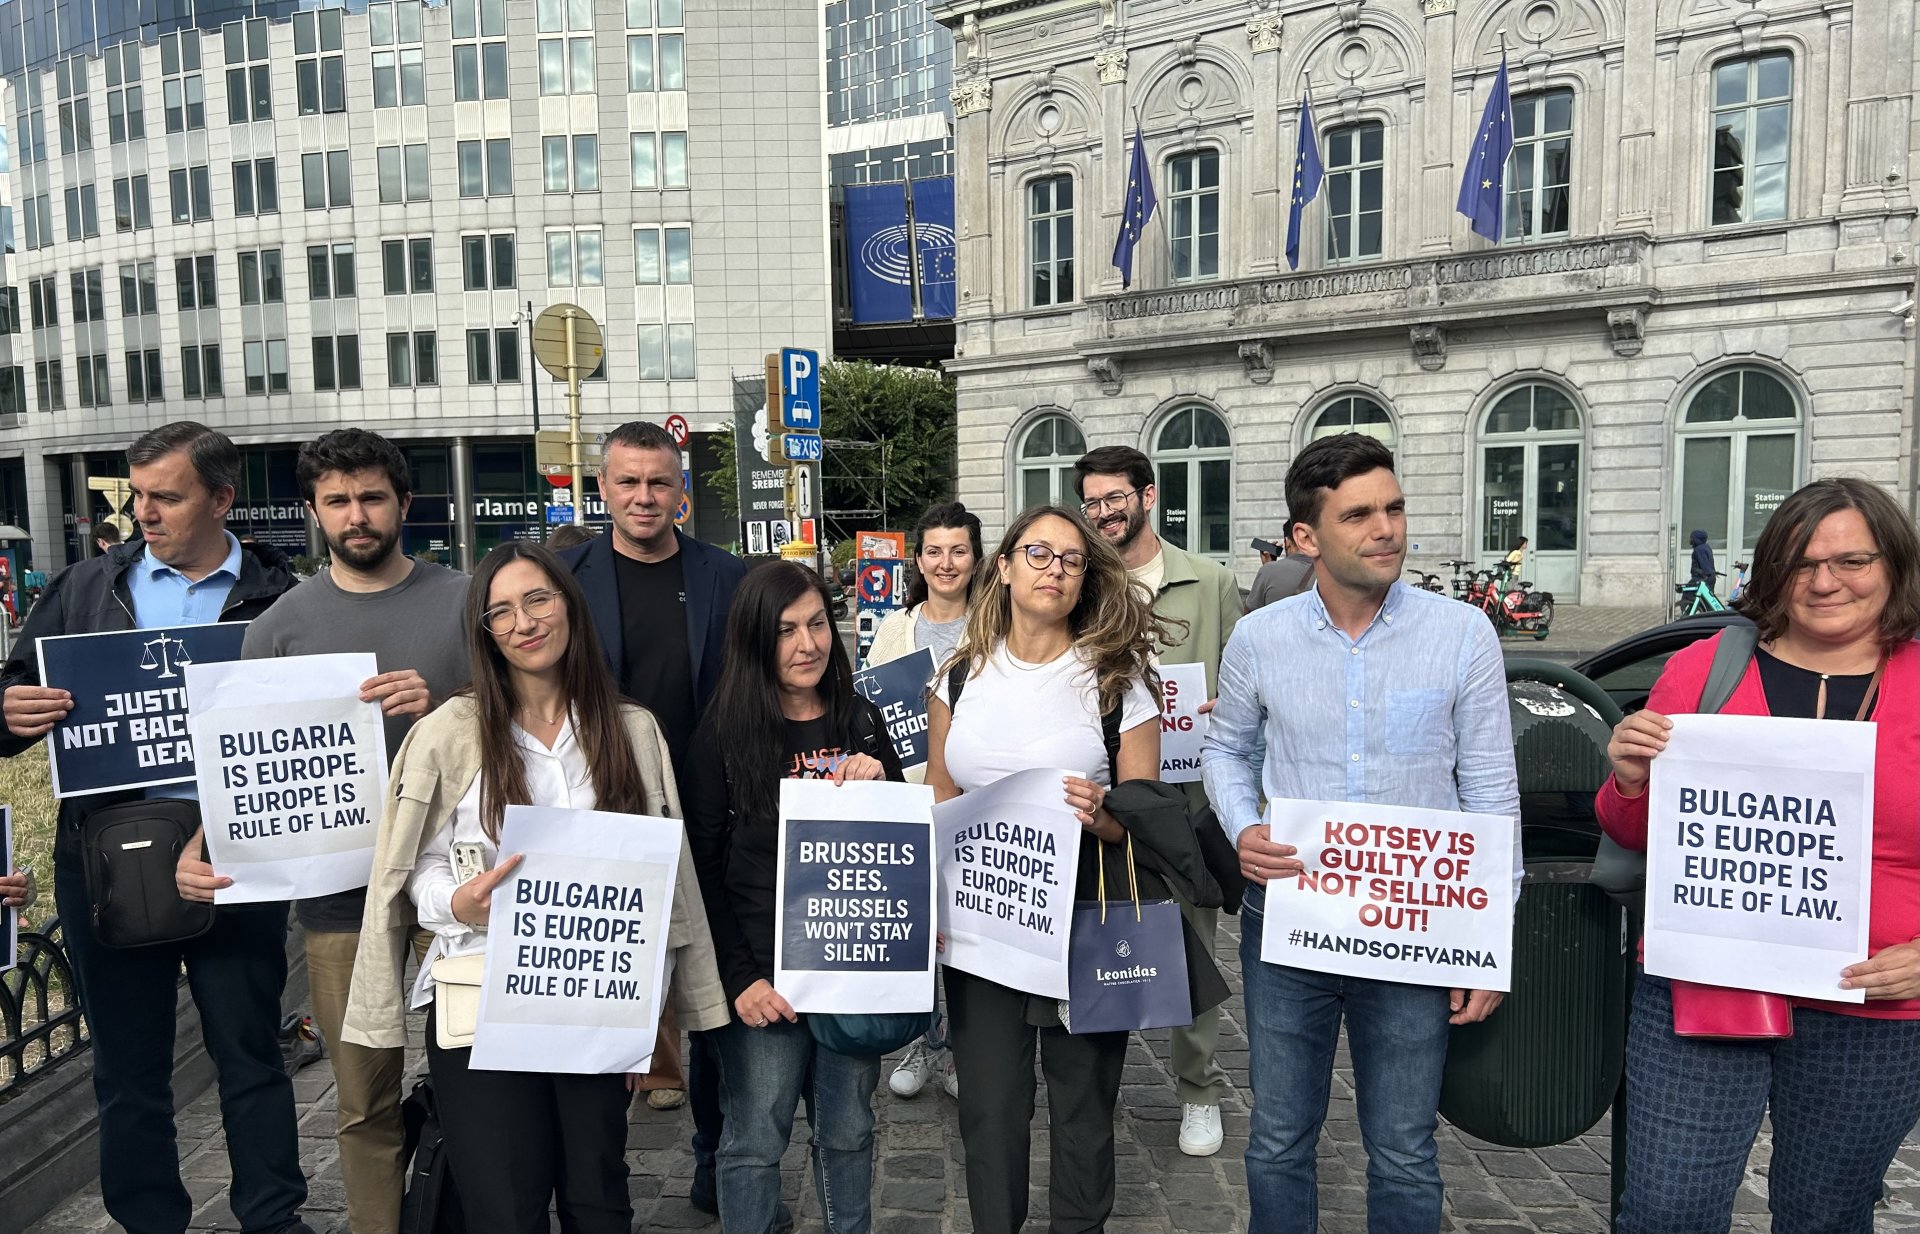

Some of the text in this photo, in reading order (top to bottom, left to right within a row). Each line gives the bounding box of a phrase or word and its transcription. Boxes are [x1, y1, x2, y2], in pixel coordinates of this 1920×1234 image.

[790, 354, 811, 395] P
[1493, 500, 1519, 508] Station
[1493, 508, 1517, 516] Europe
[1754, 493, 1785, 501] Station
[62, 722, 118, 749] NOT
[219, 722, 355, 758] BULGARIA
[223, 753, 365, 788] IS EUROPE.
[791, 748, 841, 773] JUST
[234, 783, 356, 815] EUROPE IS
[1679, 787, 1837, 827] BULGARIA
[228, 807, 370, 840] RULE OF LAW.
[954, 821, 1056, 856] BULGARIA
[1324, 821, 1475, 856] KOTSEV IS
[800, 842, 915, 865] BRUSSELS
[1677, 821, 1844, 862] IS EUROPE.
[827, 869, 887, 891] SEES.
[955, 846, 1058, 886] IS EUROPE.
[1319, 848, 1470, 882] GUILTY OF
[1684, 855, 1828, 892] EUROPE IS
[516, 879, 643, 912] BULGARIA
[962, 869, 1048, 908] EUROPE IS
[1297, 870, 1489, 910] NOT SELLING
[1673, 883, 1842, 922] RULE OF LAW.
[807, 898, 908, 918] BRUSSELS
[955, 890, 1054, 936] RULE OF LAW.
[1358, 903, 1429, 932] OUT!
[514, 912, 645, 944] IS EUROPE.
[805, 921, 912, 940] WON'T STAY
[518, 945, 632, 973] EUROPE IS
[824, 943, 890, 962] SILENT.
[1288, 929, 1498, 969] #HANDSOFFVARNA
[506, 974, 640, 1000] RULE OF LAW.
[1096, 965, 1157, 981] Leonidas
